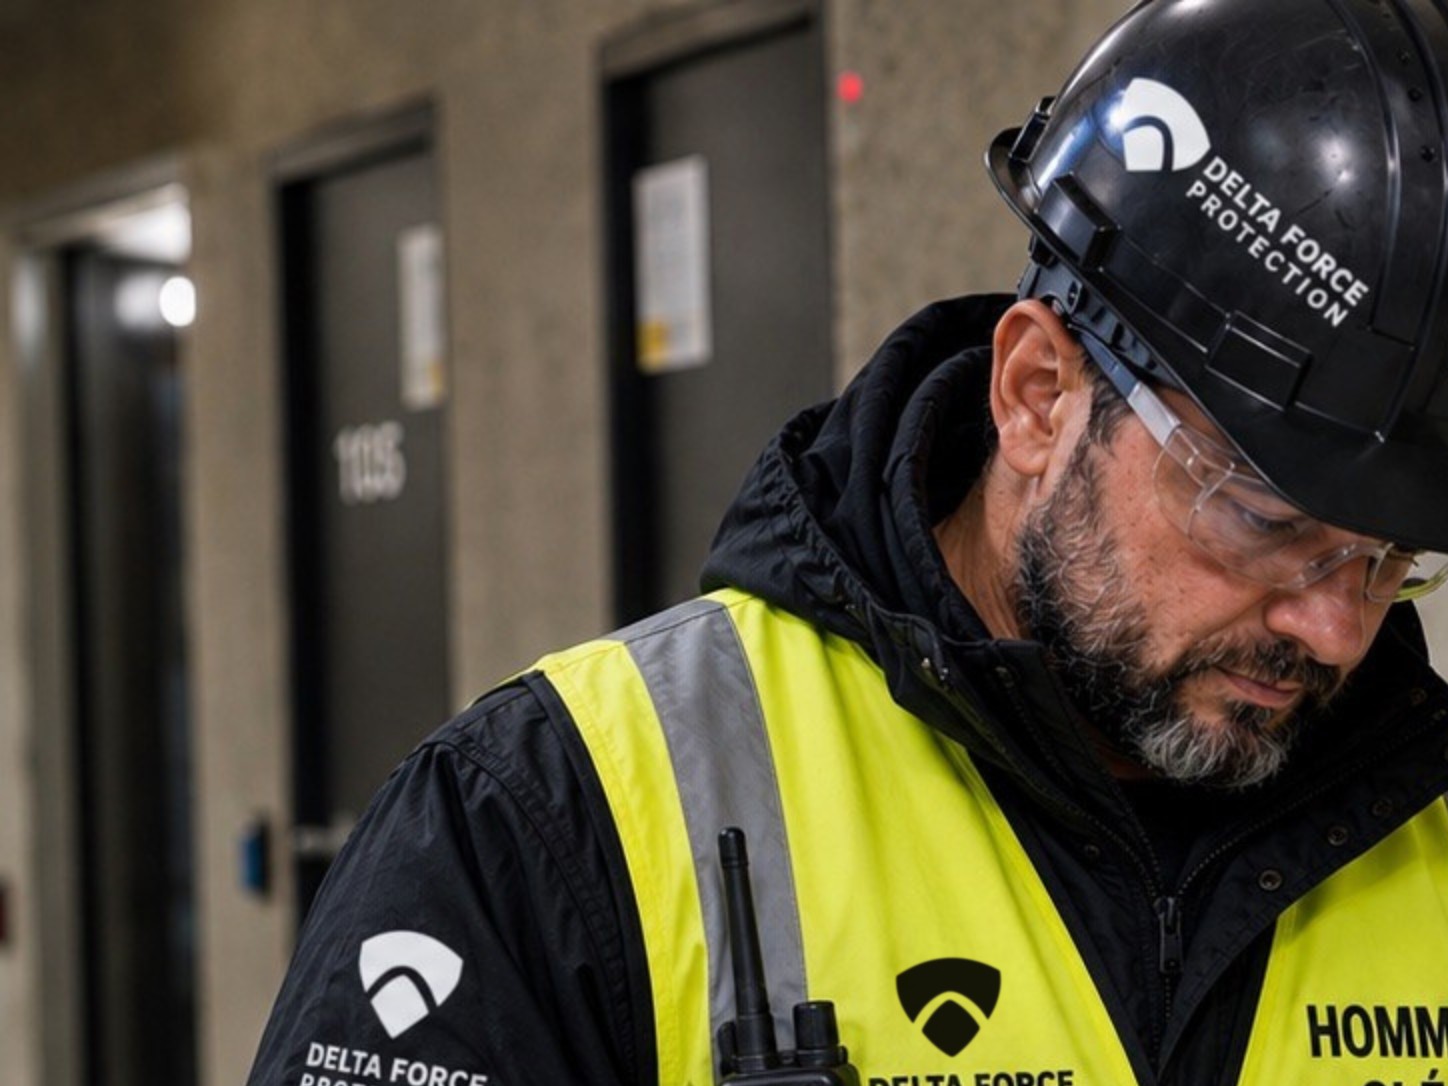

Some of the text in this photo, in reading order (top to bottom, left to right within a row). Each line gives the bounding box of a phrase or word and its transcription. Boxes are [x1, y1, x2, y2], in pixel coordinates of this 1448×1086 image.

[1185, 180, 1350, 328] PROTECTION
[1202, 155, 1369, 308] DELTA FORCE
[305, 1041, 382, 1079] DELTA
